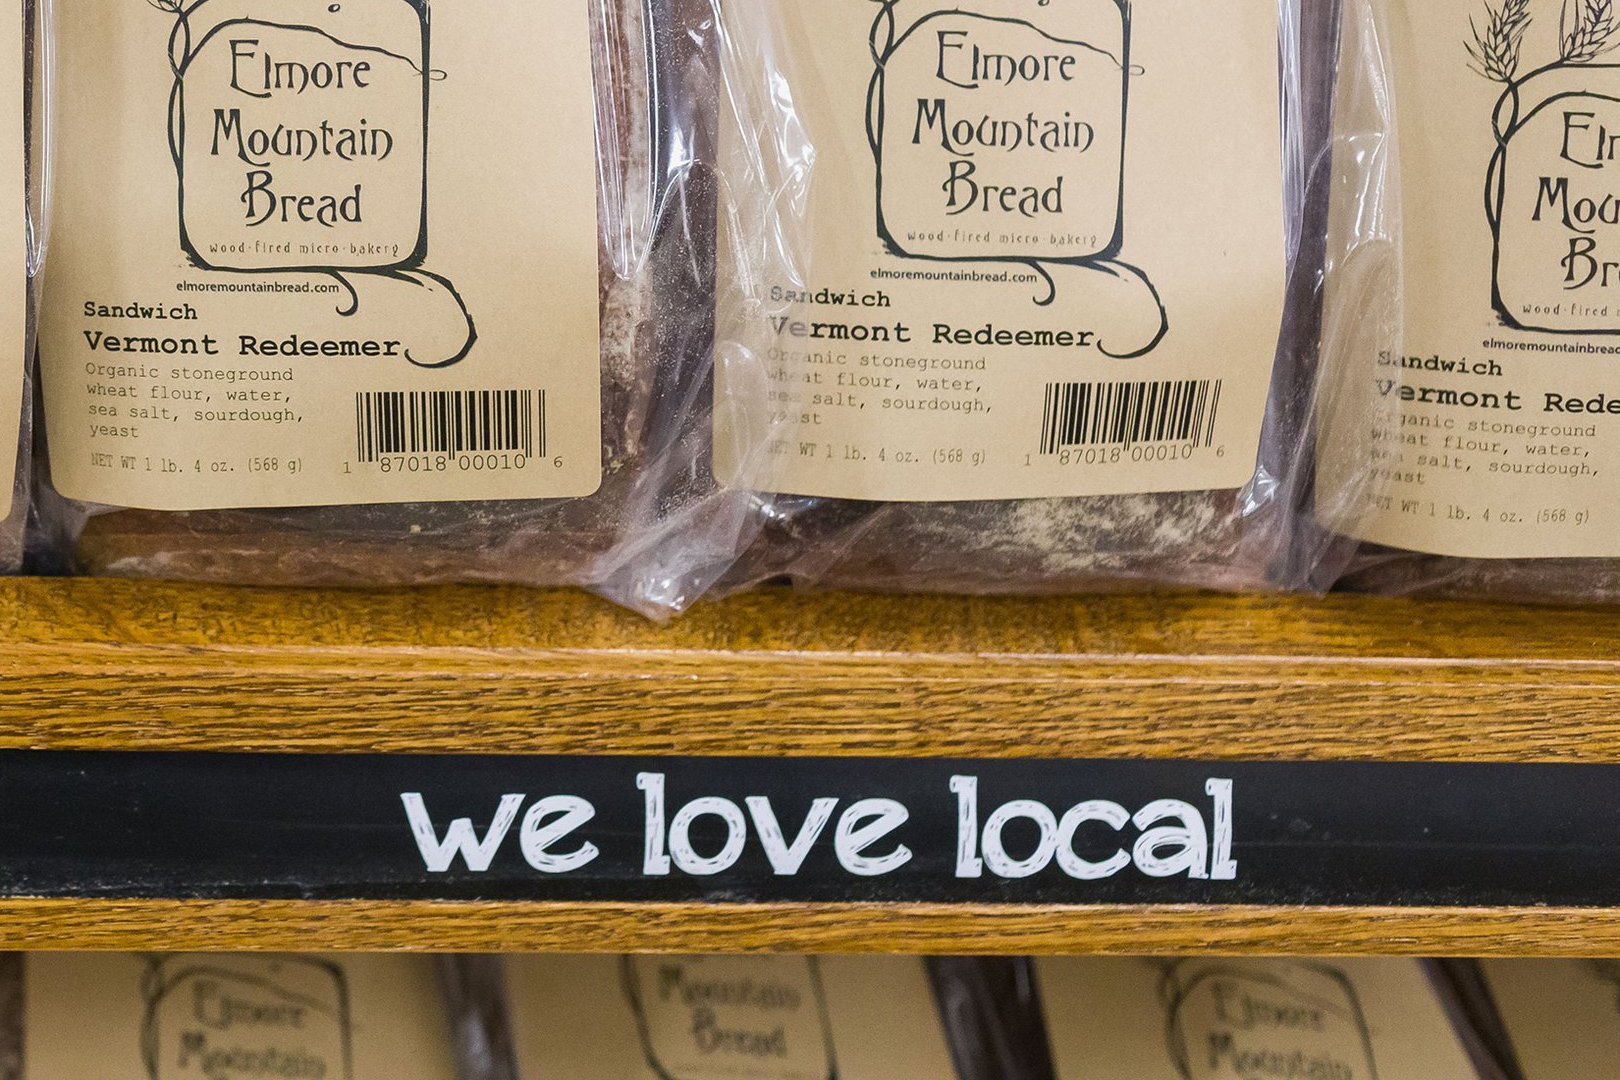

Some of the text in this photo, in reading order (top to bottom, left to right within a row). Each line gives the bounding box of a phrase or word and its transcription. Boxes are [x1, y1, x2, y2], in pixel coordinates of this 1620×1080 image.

[229, 40, 370, 98] Elmore
[936, 31, 1075, 89] Elmore
[211, 109, 393, 167] Mountain
[912, 98, 1094, 157] Mountain
[241, 170, 362, 228] Bread
[942, 160, 1063, 218] Bread
[870, 267, 1037, 282] elmoremountainbread.com
[176, 280, 339, 293] elmoremountainbread.com
[84, 301, 198, 320] Sandwich
[83, 330, 401, 356] Vermont Redeemer
[932, 323, 1094, 347] Redeemer
[86, 362, 293, 383] Organic stoneground
[860, 355, 986, 372] stoneground
[87, 383, 290, 403] wheat flour, water,
[837, 372, 980, 392] flour, water,
[812, 392, 991, 414] salt, sourdough,
[89, 405, 302, 424] sea salt, sourdough,
[90, 425, 138, 438] yeast
[1468, 420, 1595, 438] stoneground
[1060, 443, 1193, 465] 87018 00010
[1443, 435, 1508, 455] flour,
[1526, 444, 1589, 458] water,
[381, 454, 525, 472] 87018 00010
[1417, 455, 1598, 477] salt, sourdough,
[400, 772, 1234, 881] we love local
